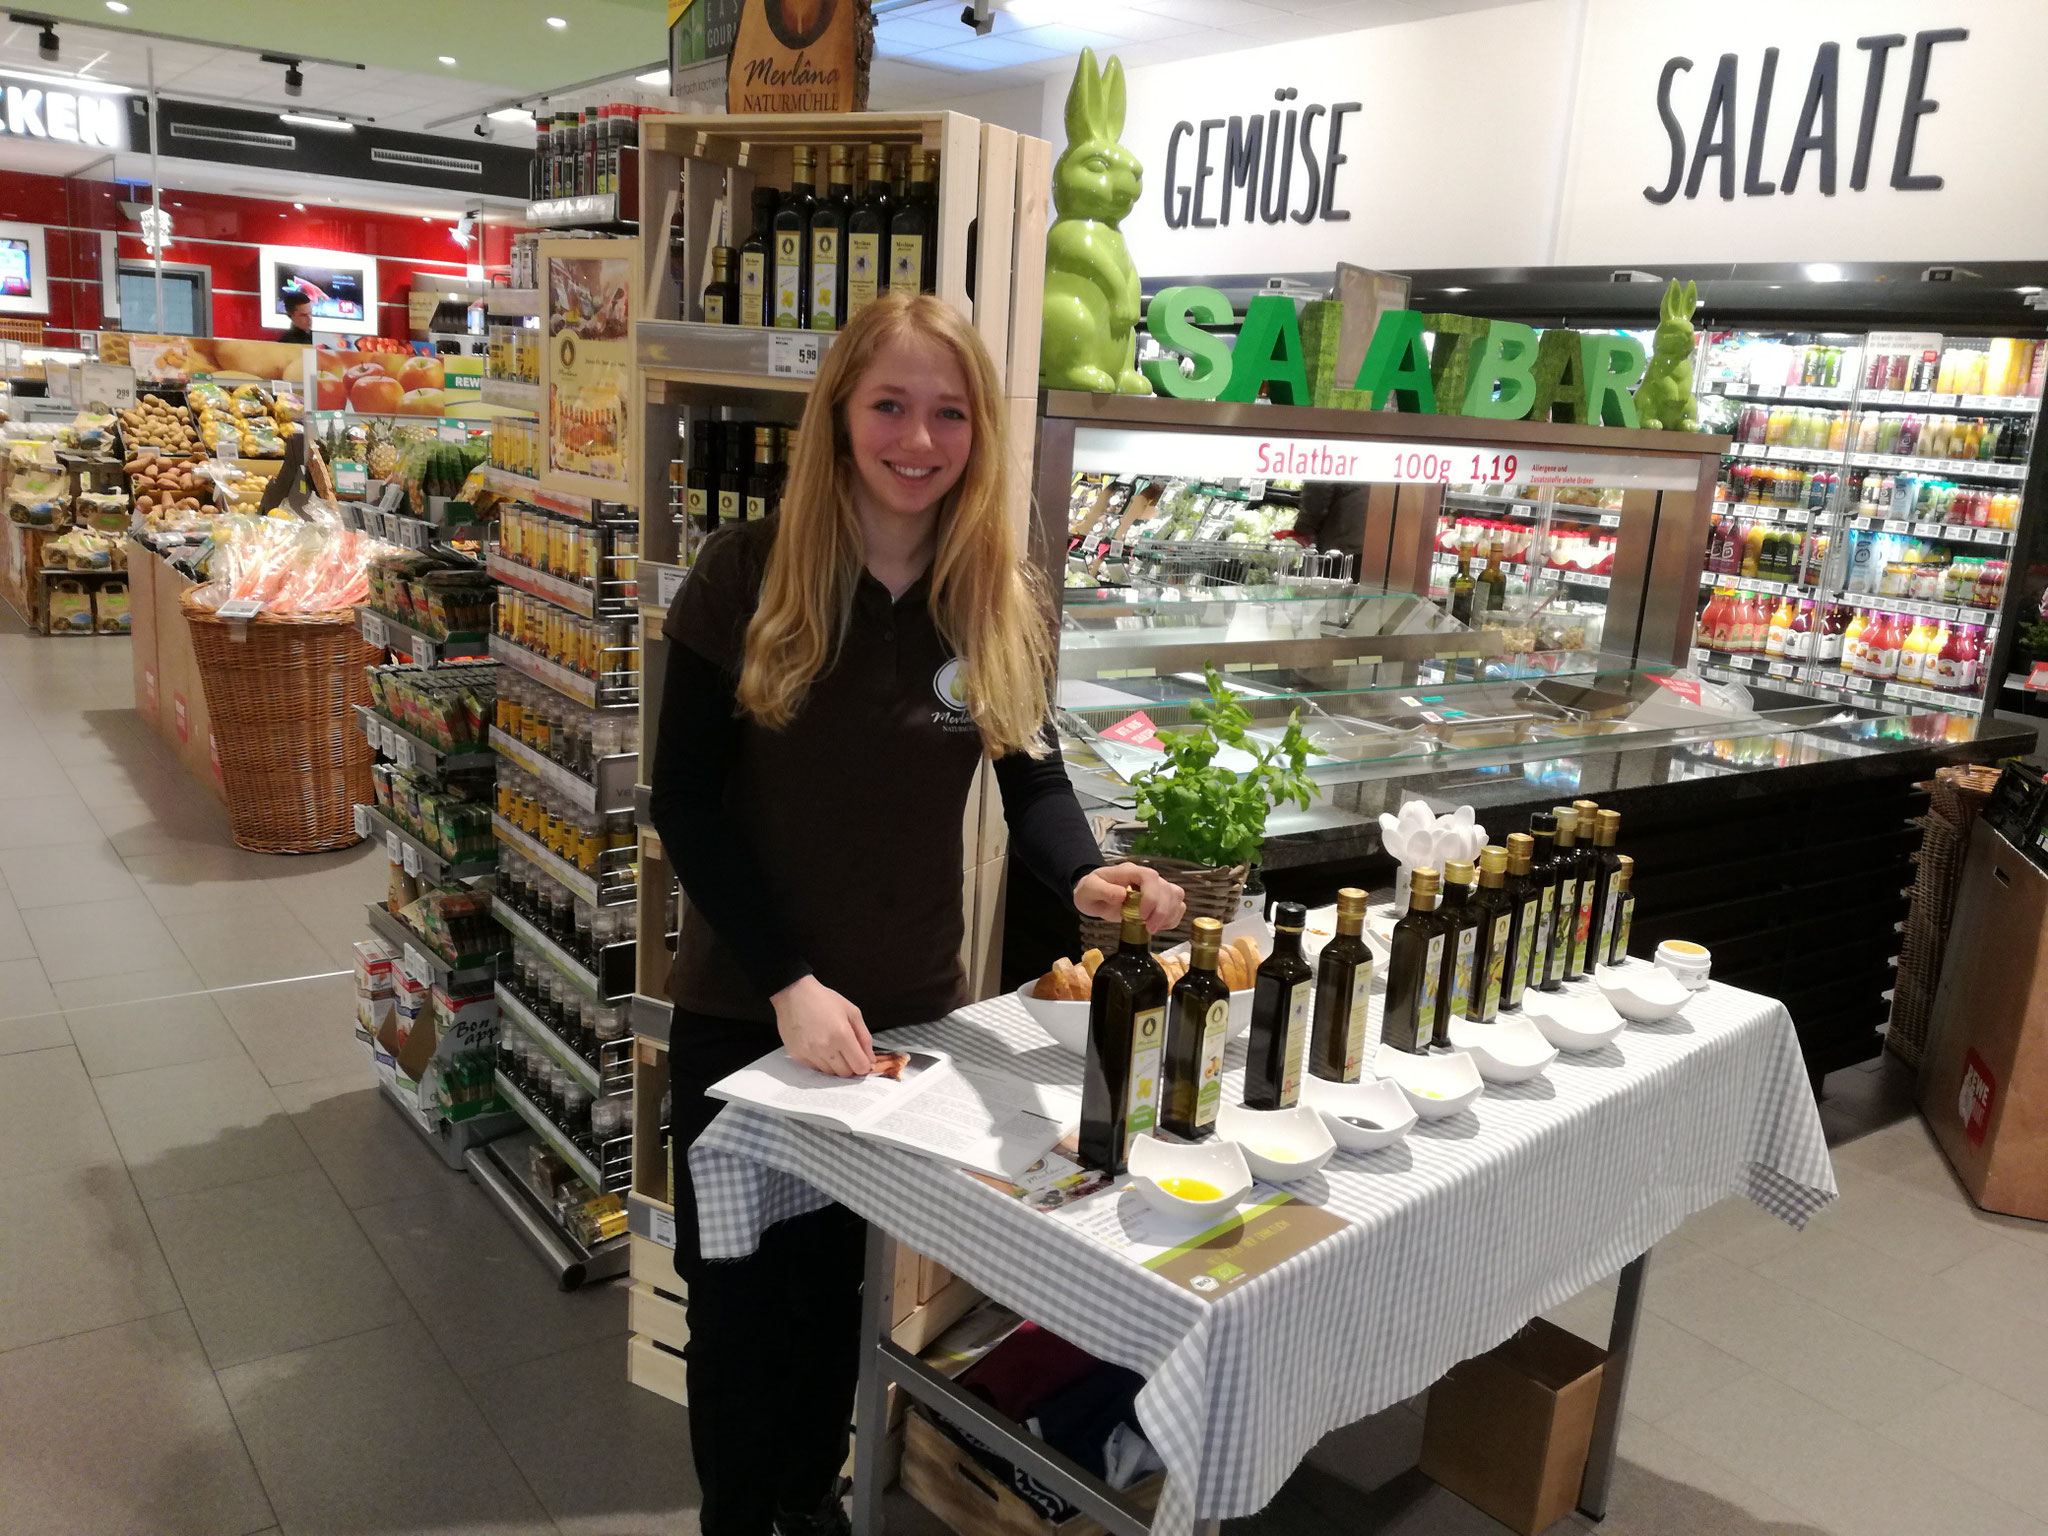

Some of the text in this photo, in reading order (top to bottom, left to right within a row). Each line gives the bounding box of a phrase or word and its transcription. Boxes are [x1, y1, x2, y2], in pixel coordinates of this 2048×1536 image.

[744, 51, 840, 86] Mevlâna
[0, 85, 119, 147] KEN
[743, 89, 839, 111] NATURMÜHLE
[1641, 28, 1970, 205] SALATE
[1164, 88, 1362, 230] GEMÜSE
[1146, 284, 1644, 429] SALATBAR
[1256, 443, 1518, 484] Salatbar 100g 1,19
[1532, 464, 1557, 473] Allergene
[450, 1018, 490, 1038] Bon
